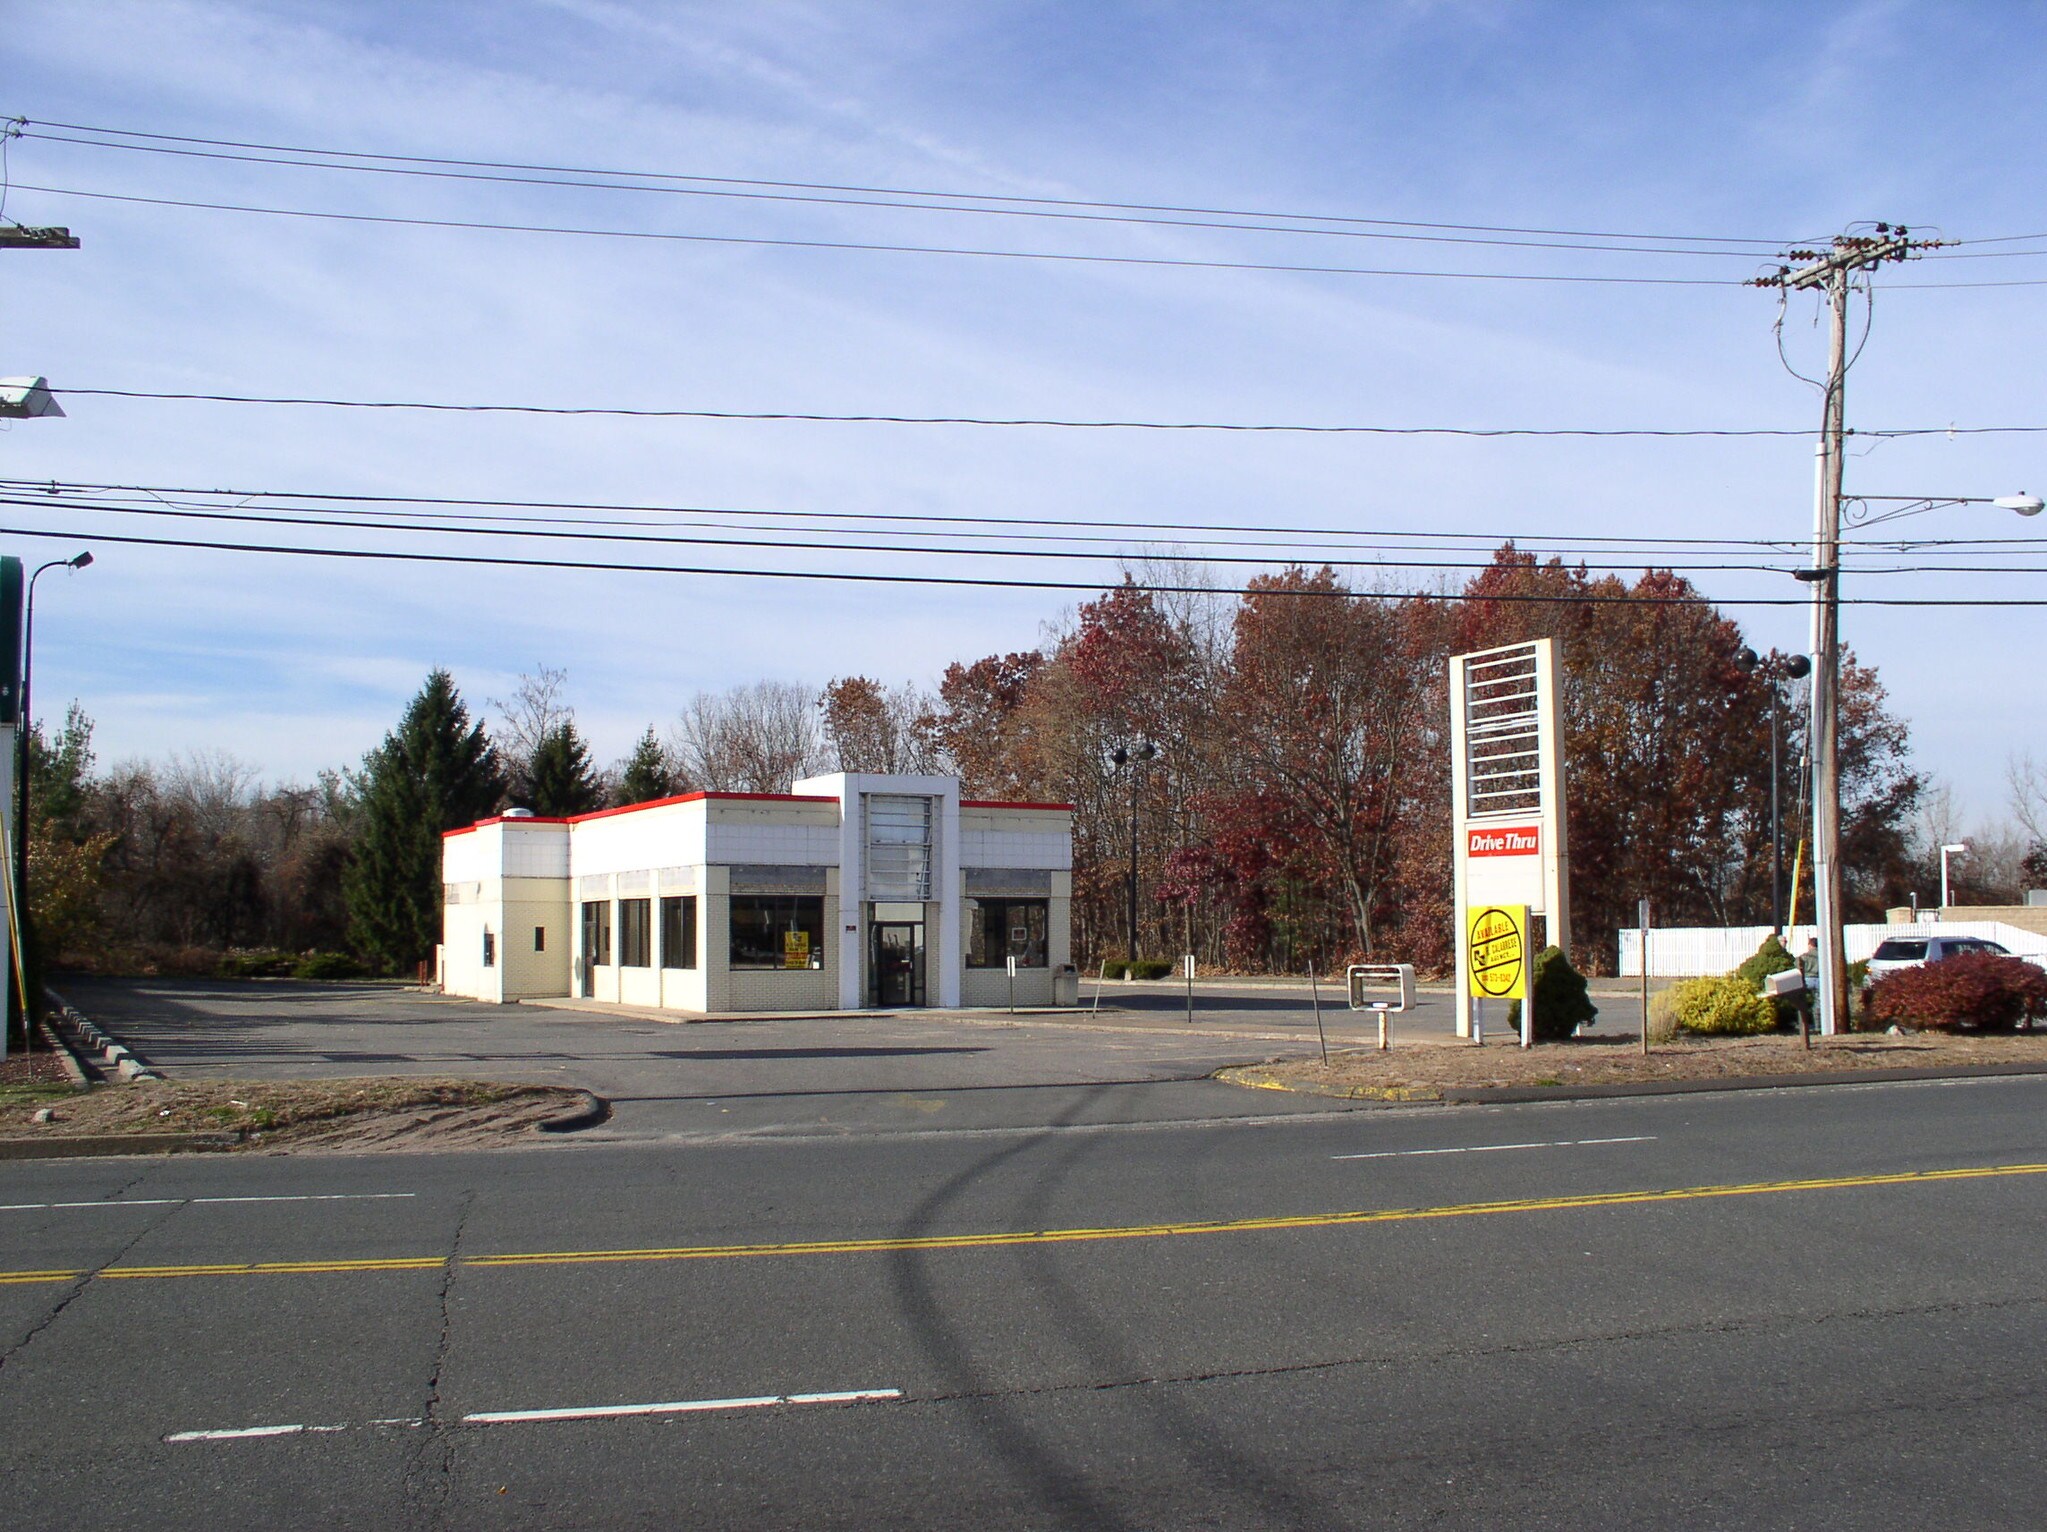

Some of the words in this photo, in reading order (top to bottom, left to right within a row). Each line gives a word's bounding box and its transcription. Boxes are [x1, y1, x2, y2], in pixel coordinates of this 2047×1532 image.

[1470, 834, 1504, 851] Drive
[1505, 833, 1536, 850] Thru
[1477, 921, 1508, 939] AVAILABLE
